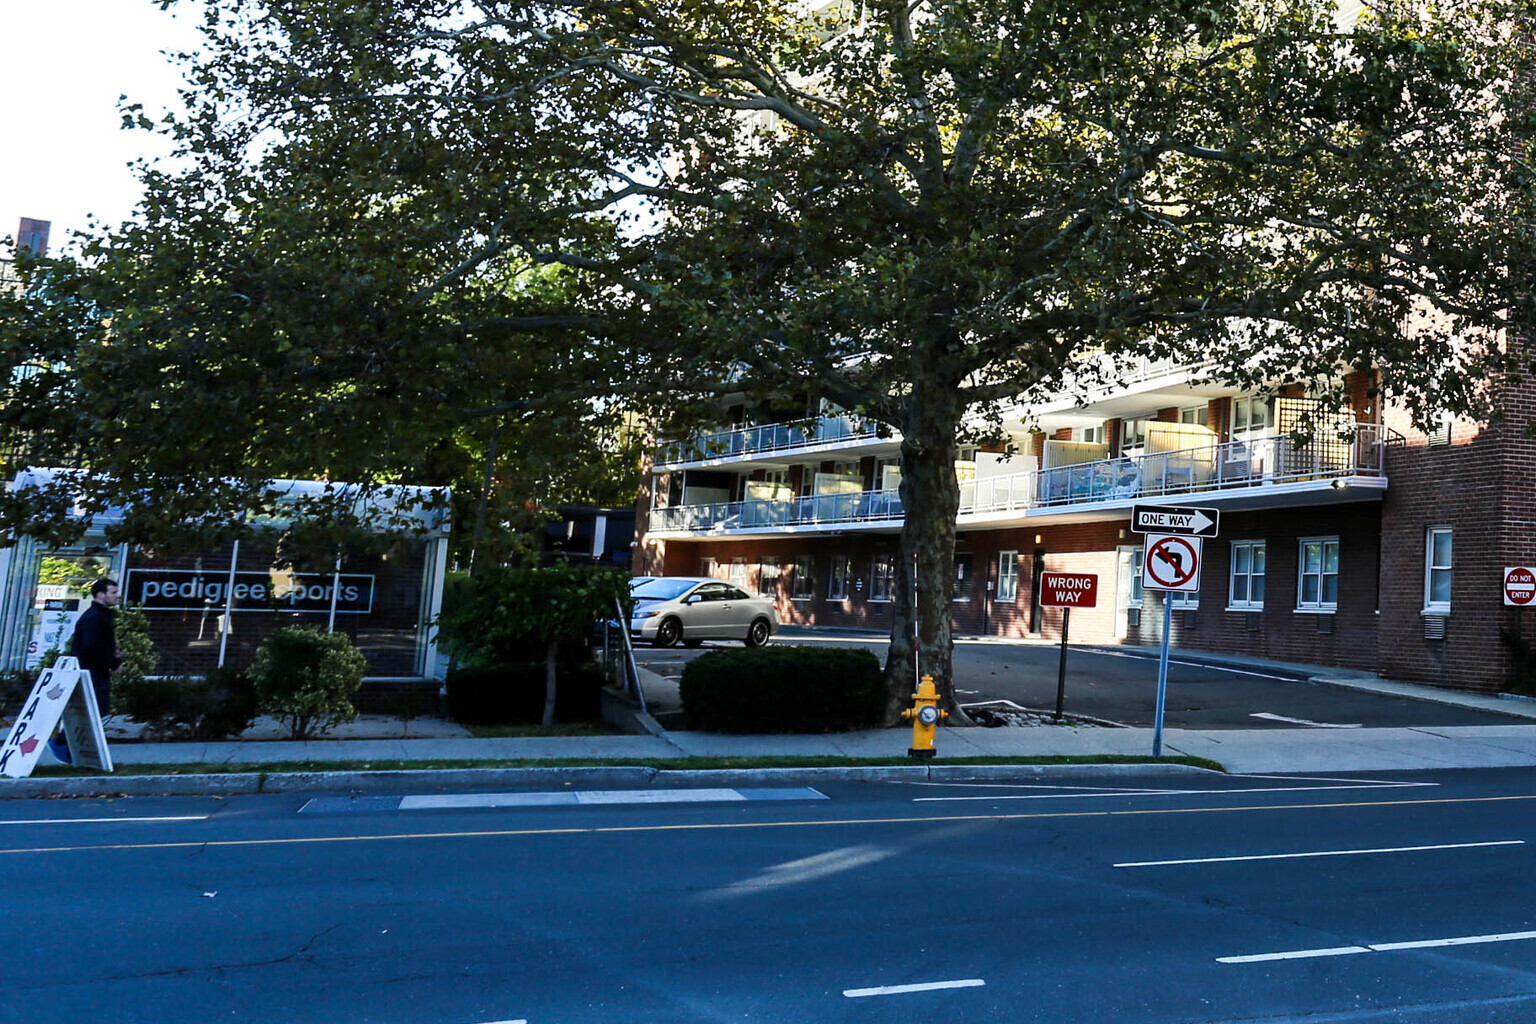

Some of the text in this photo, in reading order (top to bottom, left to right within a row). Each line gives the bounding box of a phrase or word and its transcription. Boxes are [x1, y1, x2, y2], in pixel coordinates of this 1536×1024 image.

[1141, 513, 1193, 527] ONE WAY
[1048, 576, 1092, 590] WRONG
[141, 576, 359, 605] pedigree sports
[1055, 591, 1082, 603] WAY
[1511, 591, 1530, 599] ENTER
[0, 671, 53, 773] PARK
